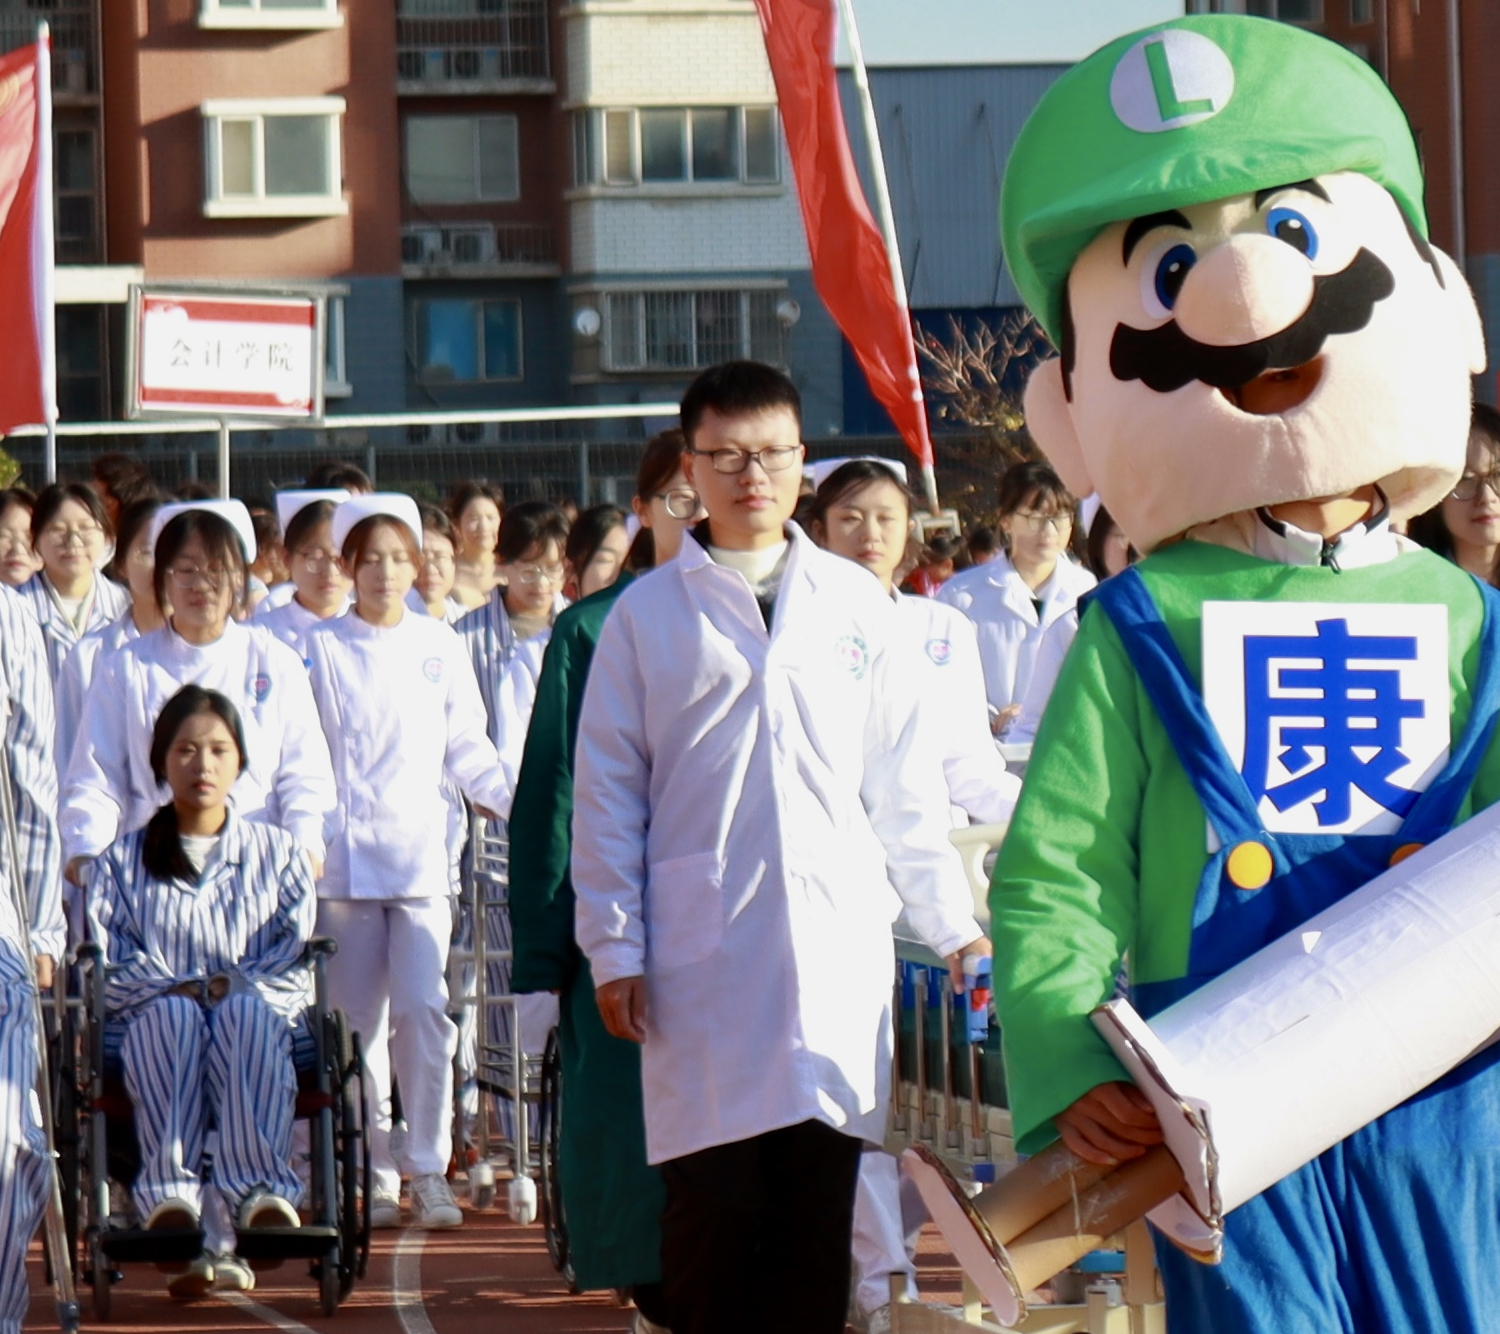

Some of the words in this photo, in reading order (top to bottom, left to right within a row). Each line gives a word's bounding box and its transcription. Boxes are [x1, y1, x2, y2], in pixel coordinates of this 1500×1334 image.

[1143, 40, 1215, 122] L
[170, 338, 295, 372] 会计学院
[1240, 618, 1426, 827] 康
